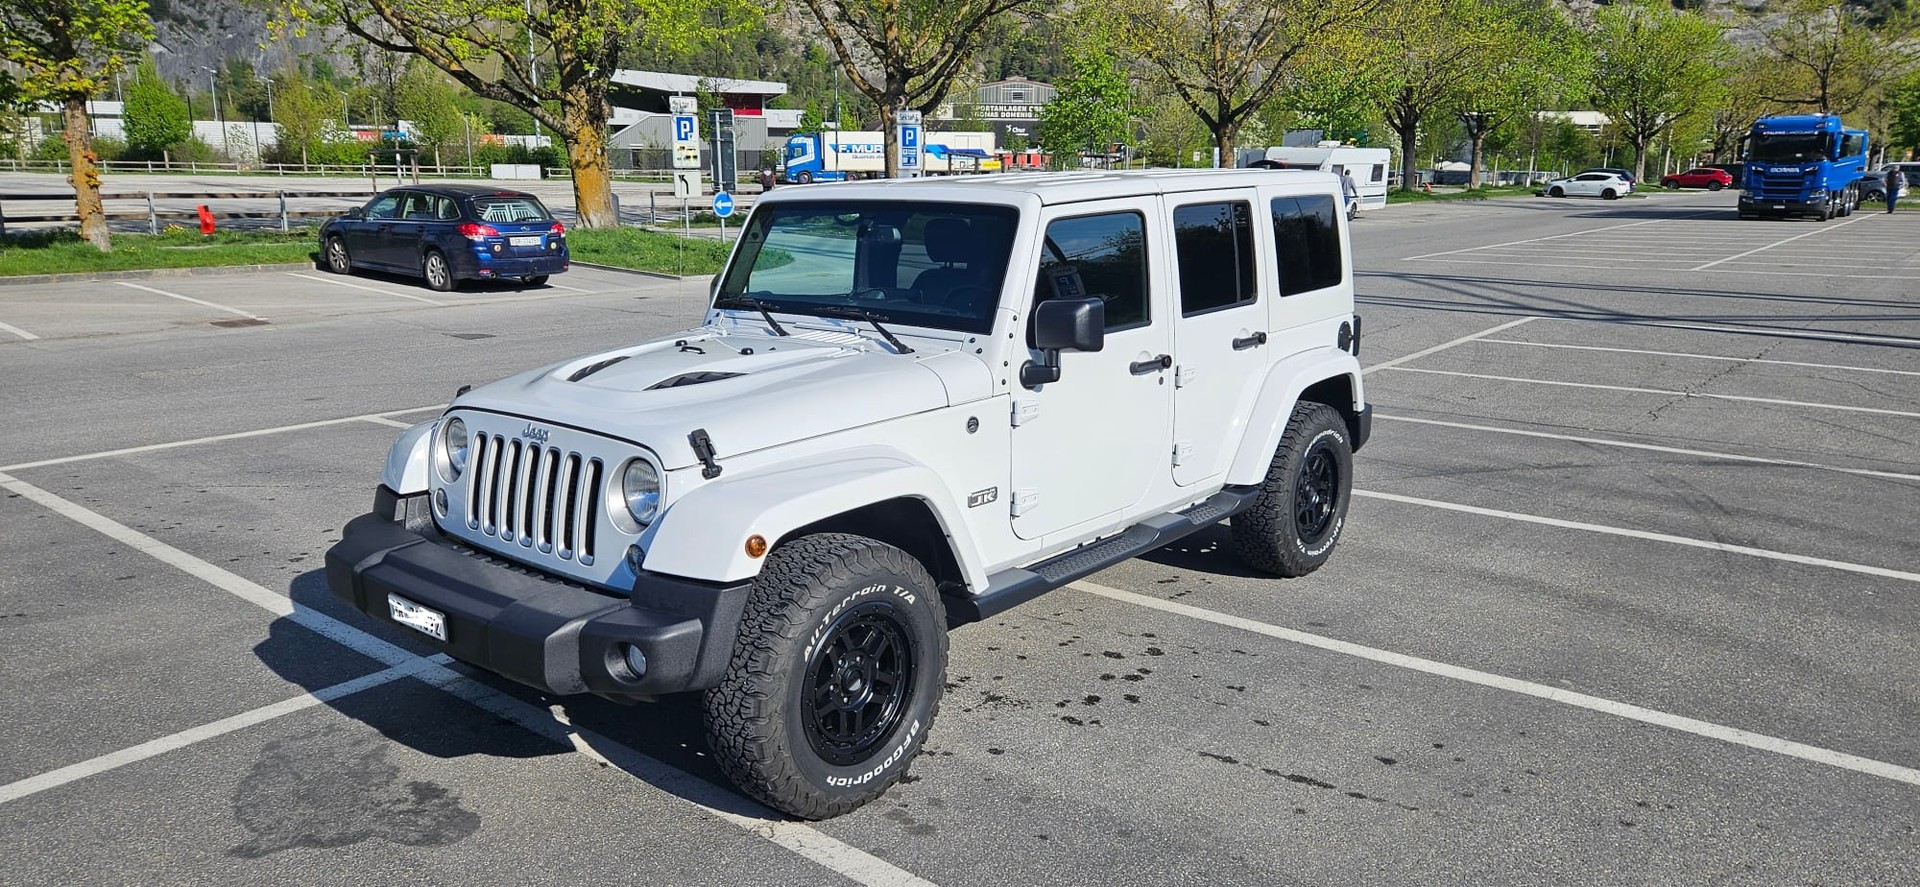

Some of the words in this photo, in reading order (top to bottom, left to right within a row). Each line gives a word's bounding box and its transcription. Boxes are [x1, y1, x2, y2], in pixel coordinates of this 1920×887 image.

[680, 120, 690, 139] P
[905, 129, 914, 145] P
[521, 422, 550, 445] Jeep
[803, 583, 887, 663] All-Terrain
[893, 584, 916, 606] T/A
[826, 719, 920, 788] BFGoodrich
